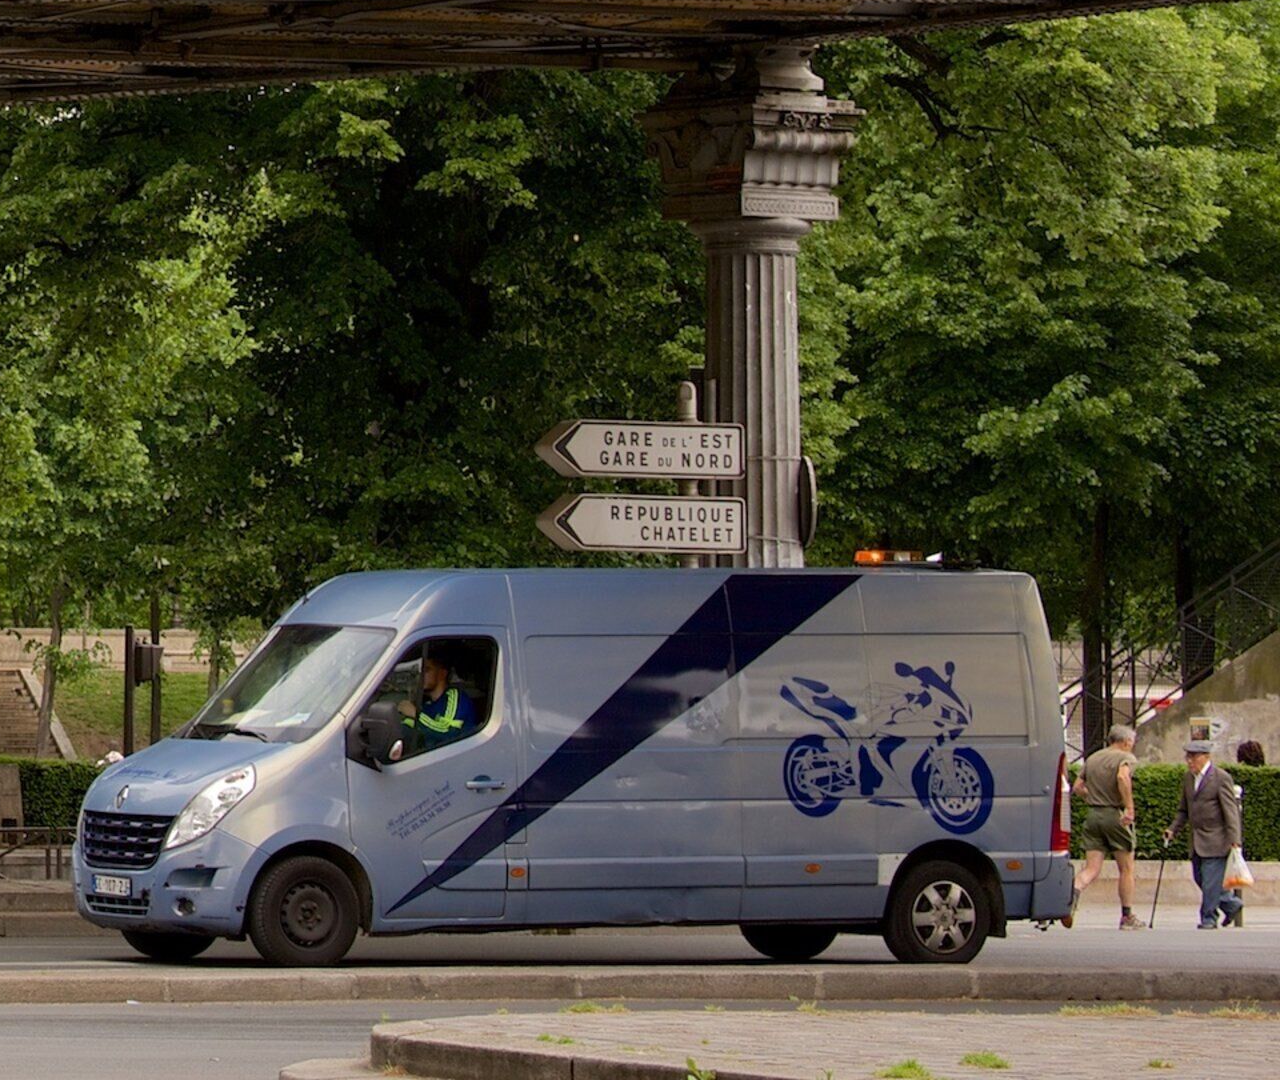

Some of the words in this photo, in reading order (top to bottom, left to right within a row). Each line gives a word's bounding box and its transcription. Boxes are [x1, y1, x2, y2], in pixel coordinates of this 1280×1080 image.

[603, 431, 653, 447] GARE
[662, 437, 676, 448] DE
[600, 451, 649, 466] GARE
[658, 457, 672, 467] DU
[681, 453, 733, 469] NORD
[640, 525, 733, 542] CHATELET
